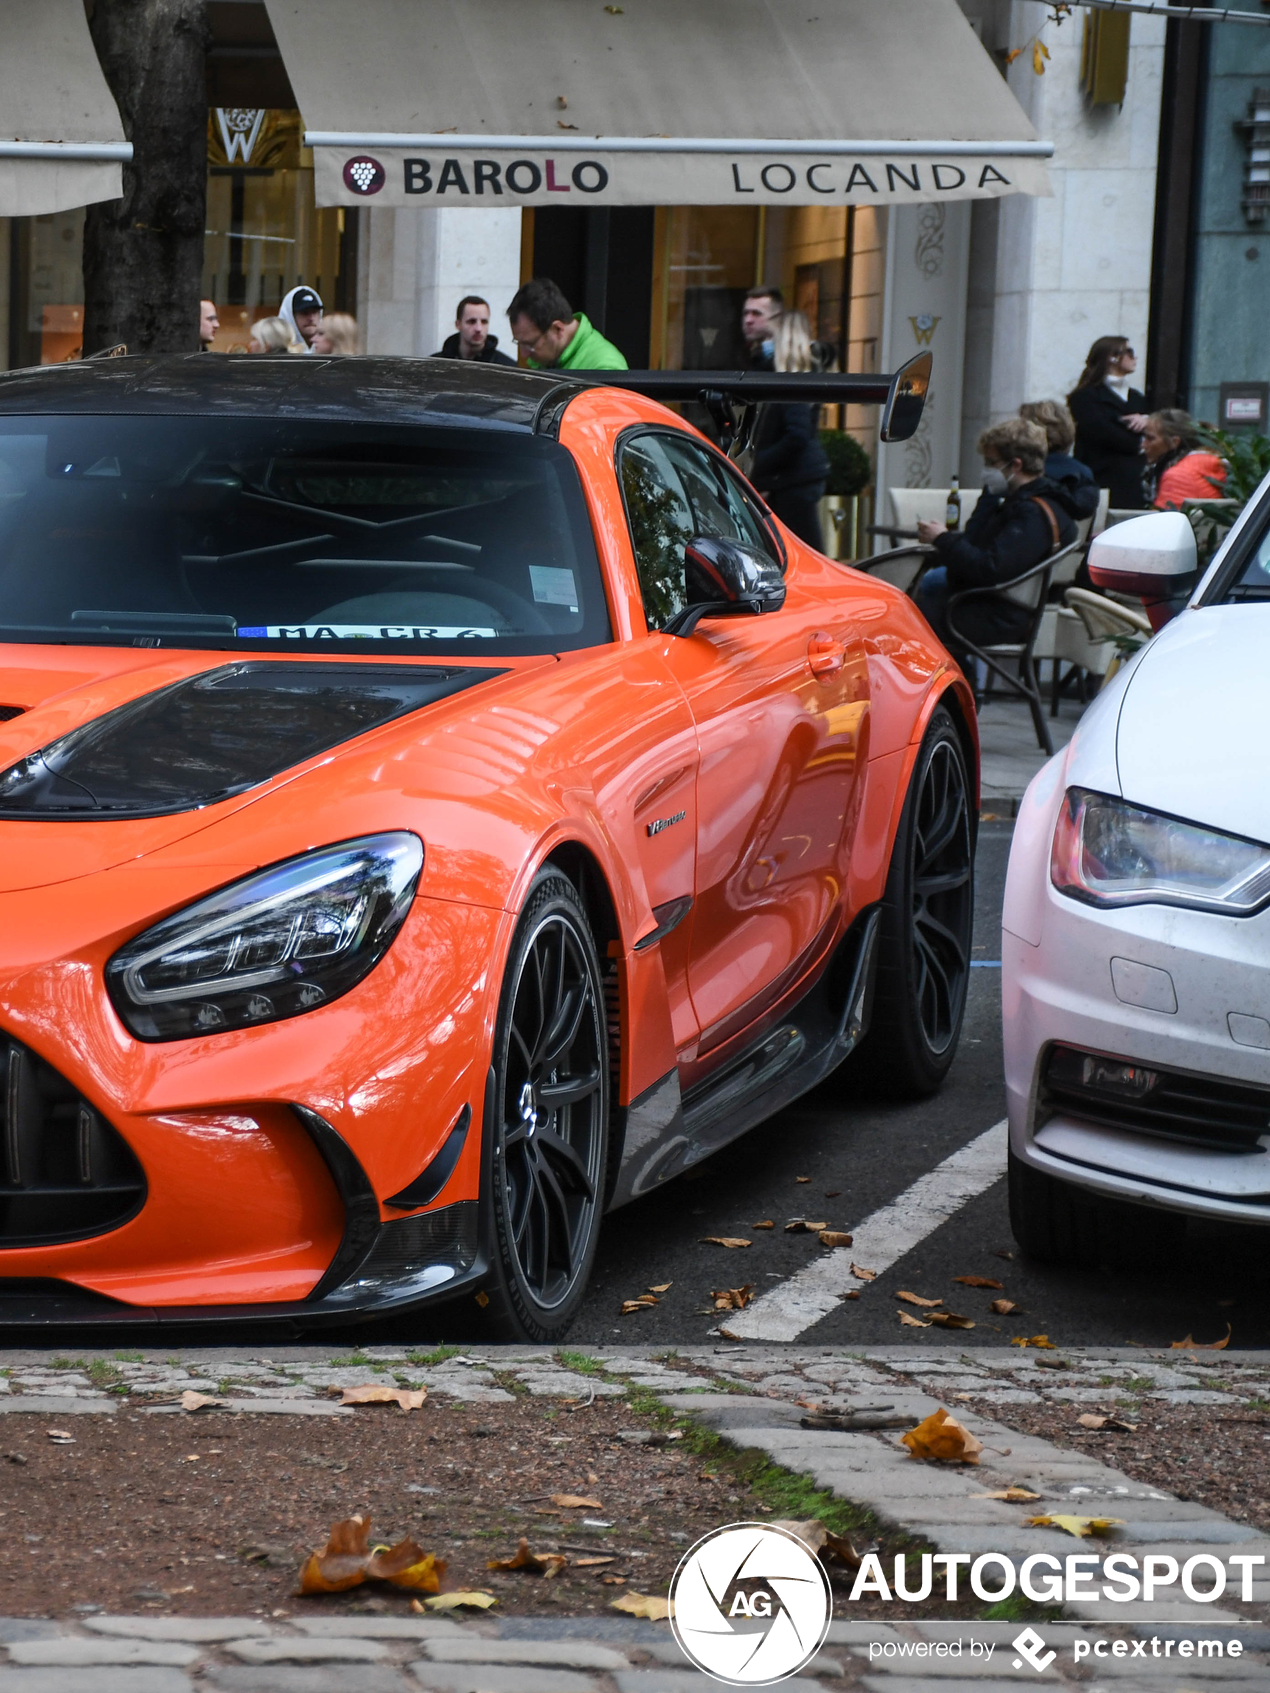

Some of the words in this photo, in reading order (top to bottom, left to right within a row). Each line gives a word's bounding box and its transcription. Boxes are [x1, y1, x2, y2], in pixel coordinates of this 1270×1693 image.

[403, 157, 609, 195] BAROLO
[731, 163, 1012, 194] LOCANDA
[279, 627, 340, 638] MA
